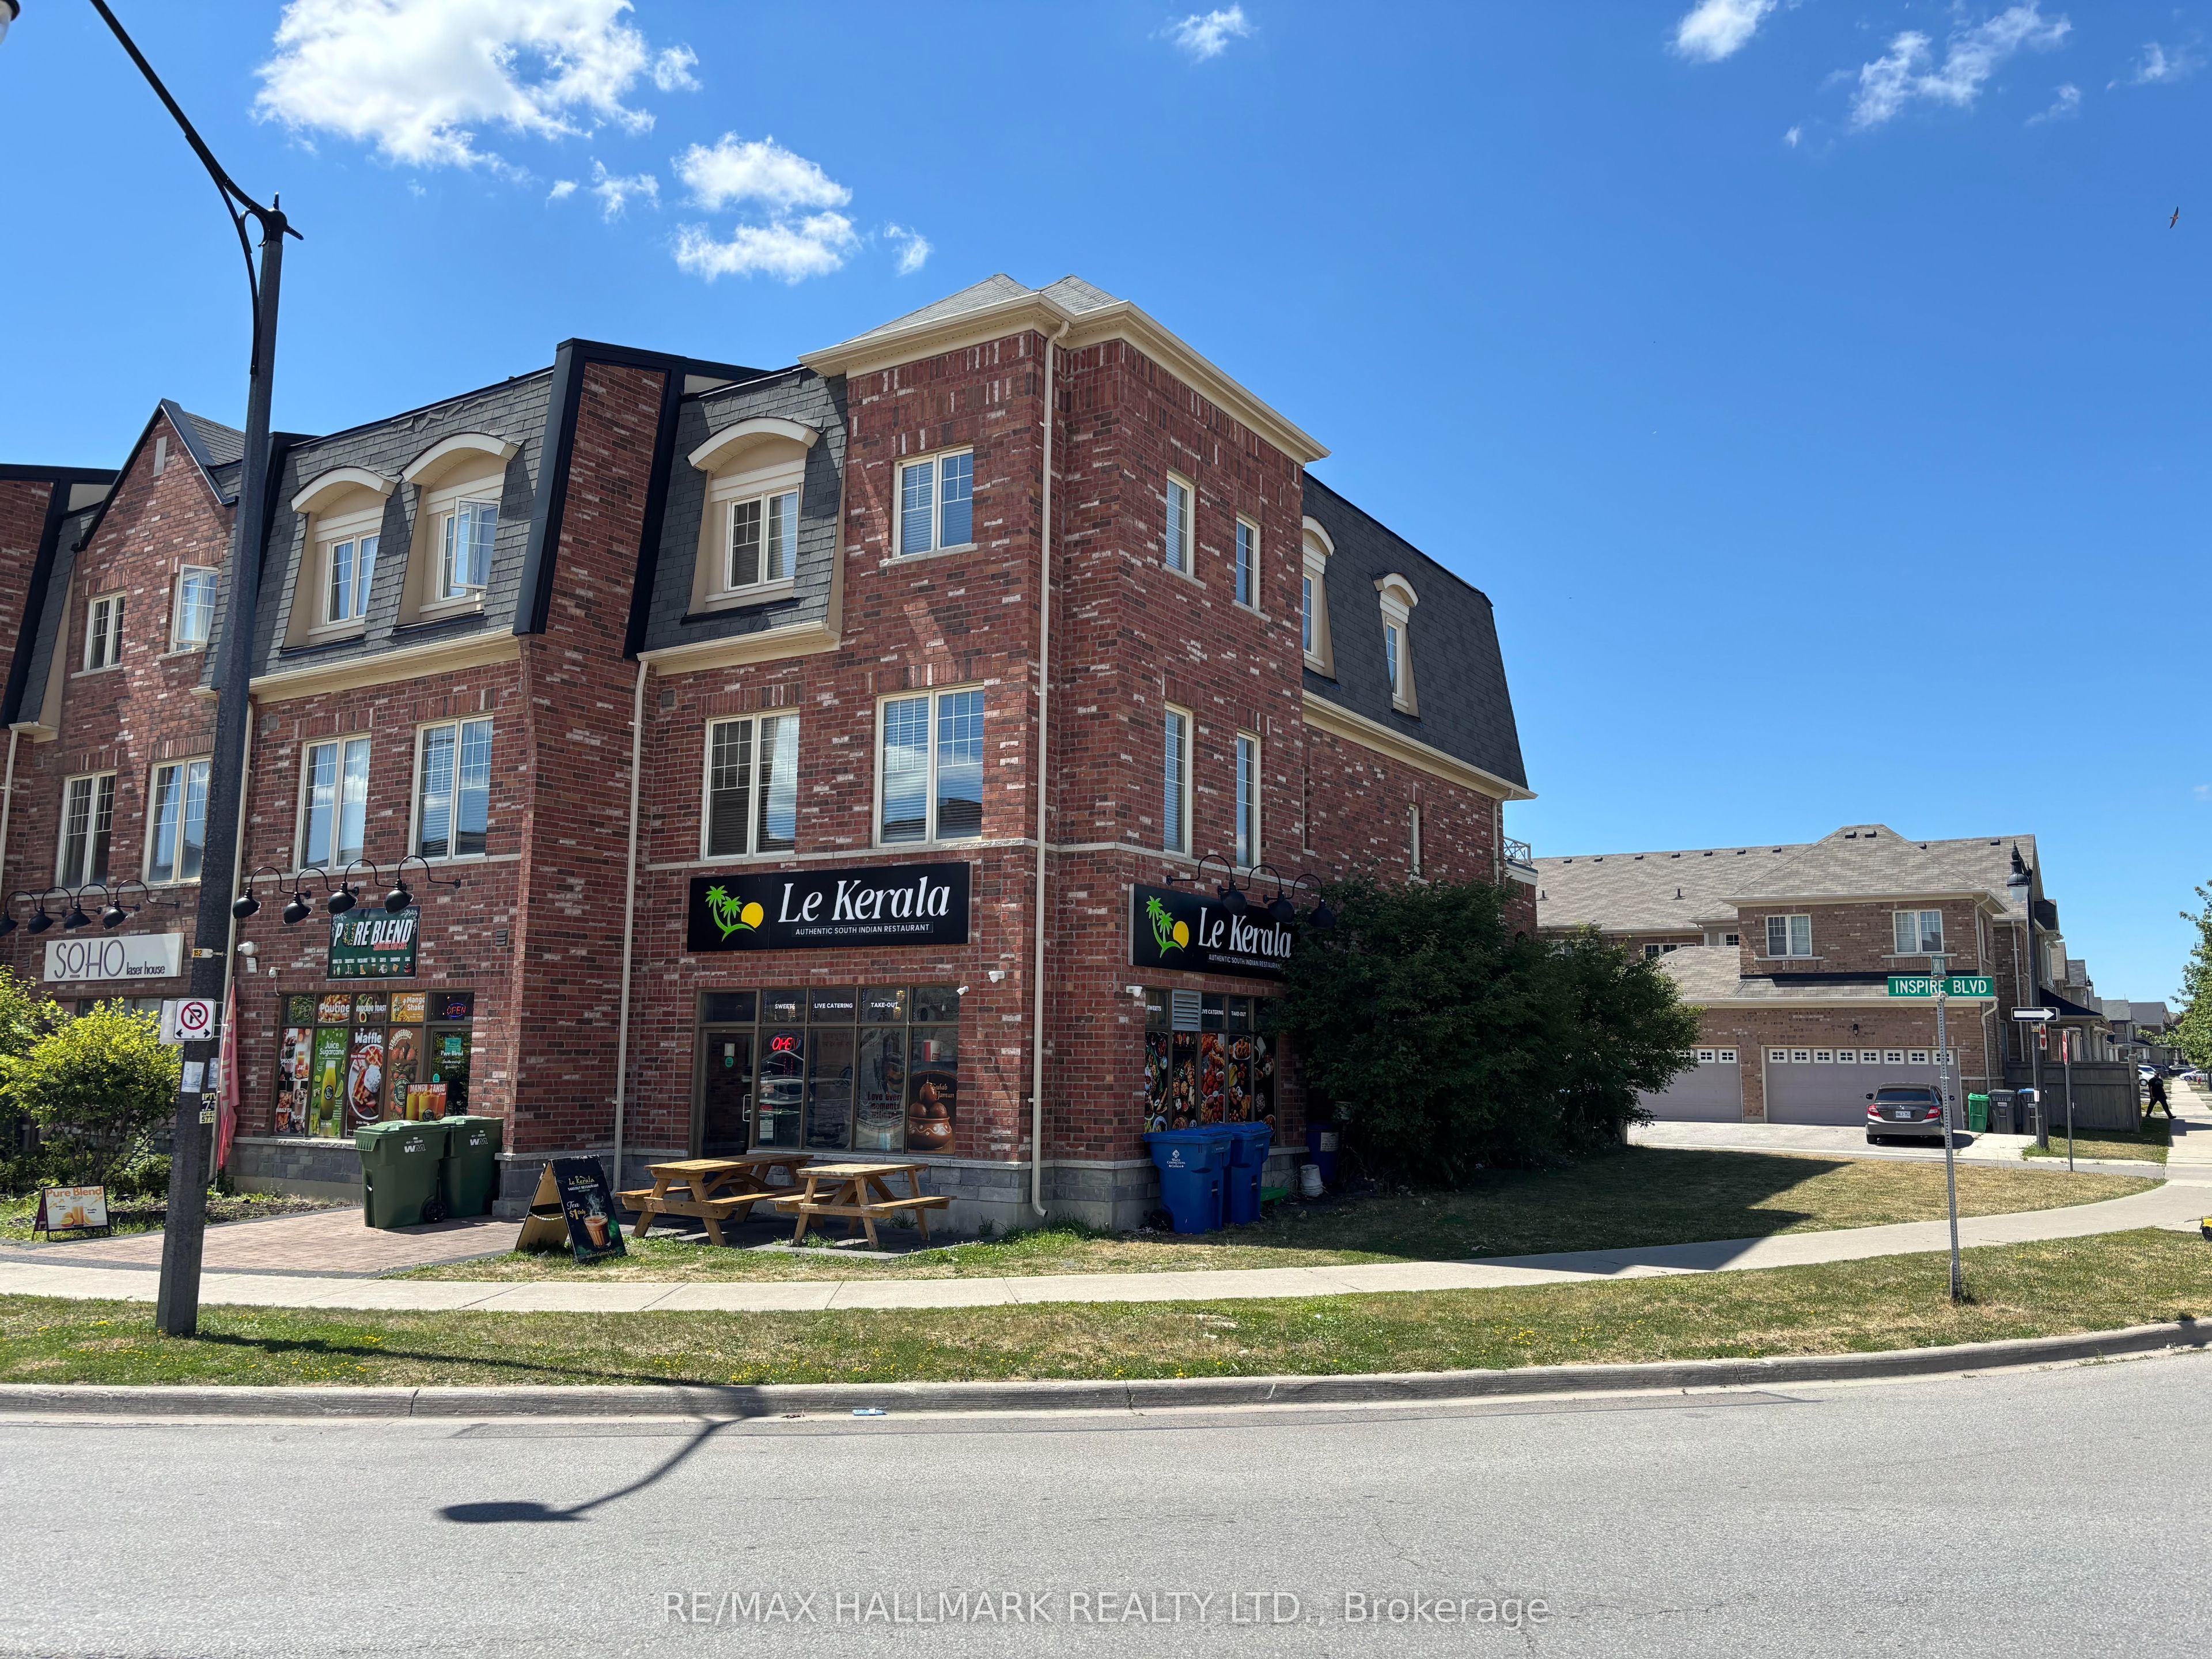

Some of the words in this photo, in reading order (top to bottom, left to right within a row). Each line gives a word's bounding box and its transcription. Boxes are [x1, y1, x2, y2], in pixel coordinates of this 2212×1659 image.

[778, 883, 823, 923] Le
[831, 876, 950, 921] Kerala
[333, 921, 372, 946] PURE
[370, 919, 414, 945] BLEND
[796, 927, 833, 935] AUTHENTIC
[884, 924, 930, 933] RESTAURANT
[1198, 907, 1225, 948] Le
[1229, 914, 1291, 958] Kerala
[54, 940, 124, 978] SOHO
[126, 962, 143, 975] laser
[144, 961, 165, 975] house
[1209, 954, 1231, 963] AUTHENTIC
[1895, 980, 1946, 994] INSPIRE
[1953, 980, 1987, 993] BLVD
[320, 1002, 350, 1013] Poutine
[446, 1006, 466, 1014] OPEN
[355, 1032, 382, 1044] Waffle
[325, 1041, 339, 1049] Juice
[772, 1037, 799, 1051] OPEN
[320, 1048, 344, 1056] Sugarcane
[868, 1092, 883, 1101] Love
[404, 1144, 426, 1153] WM
[575, 1175, 594, 1184] Kerala
[46, 1188, 71, 1198] Pure
[73, 1187, 102, 1196] Blend
[567, 1200, 579, 1210] Tea
[569, 1209, 579, 1219] $1
